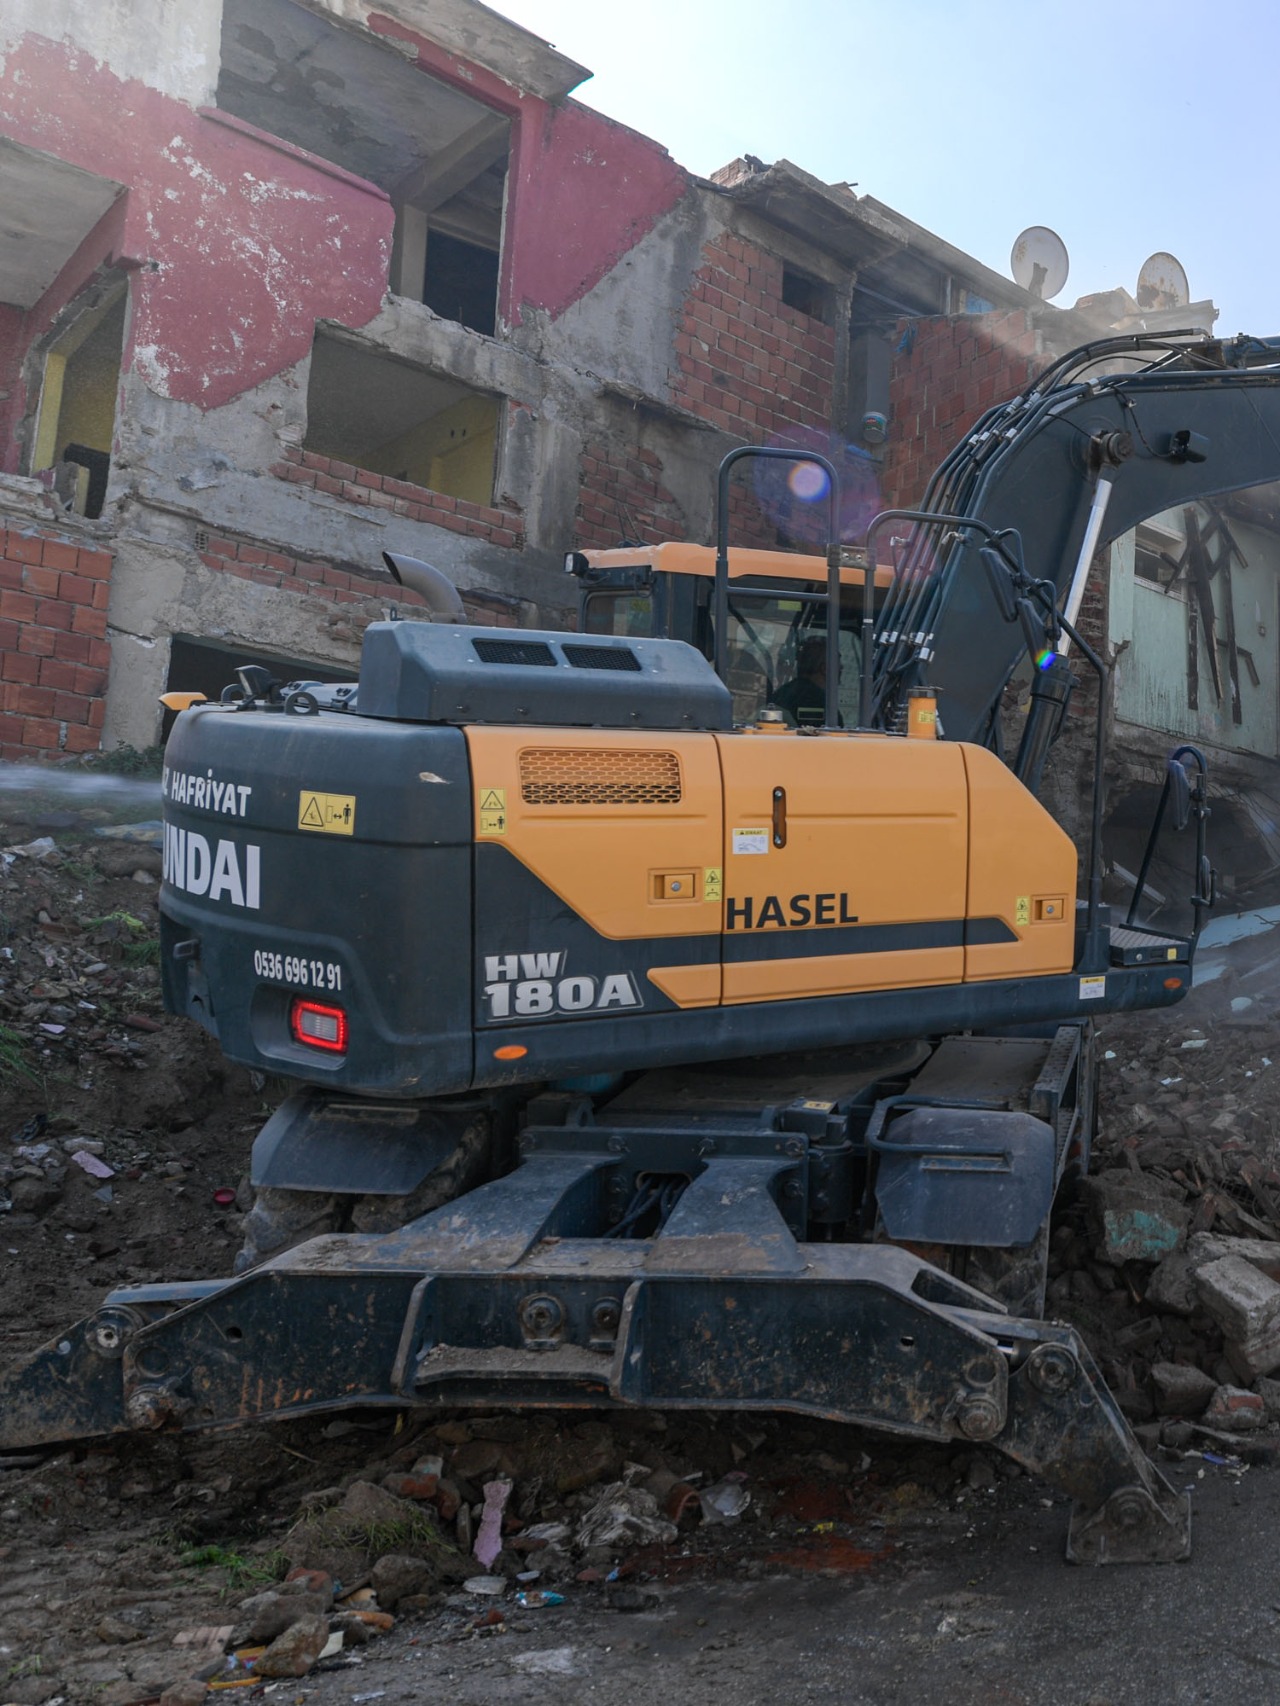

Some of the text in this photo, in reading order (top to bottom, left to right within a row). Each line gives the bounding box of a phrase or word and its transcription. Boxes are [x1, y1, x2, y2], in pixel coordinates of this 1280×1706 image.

[171, 768, 252, 817] HAFRİYAT
[162, 818, 261, 910] UNDAI
[727, 893, 858, 930] HASEL
[254, 949, 342, 991] 0536 696 12 91
[484, 952, 562, 982] HW
[484, 974, 637, 1017] 180A
